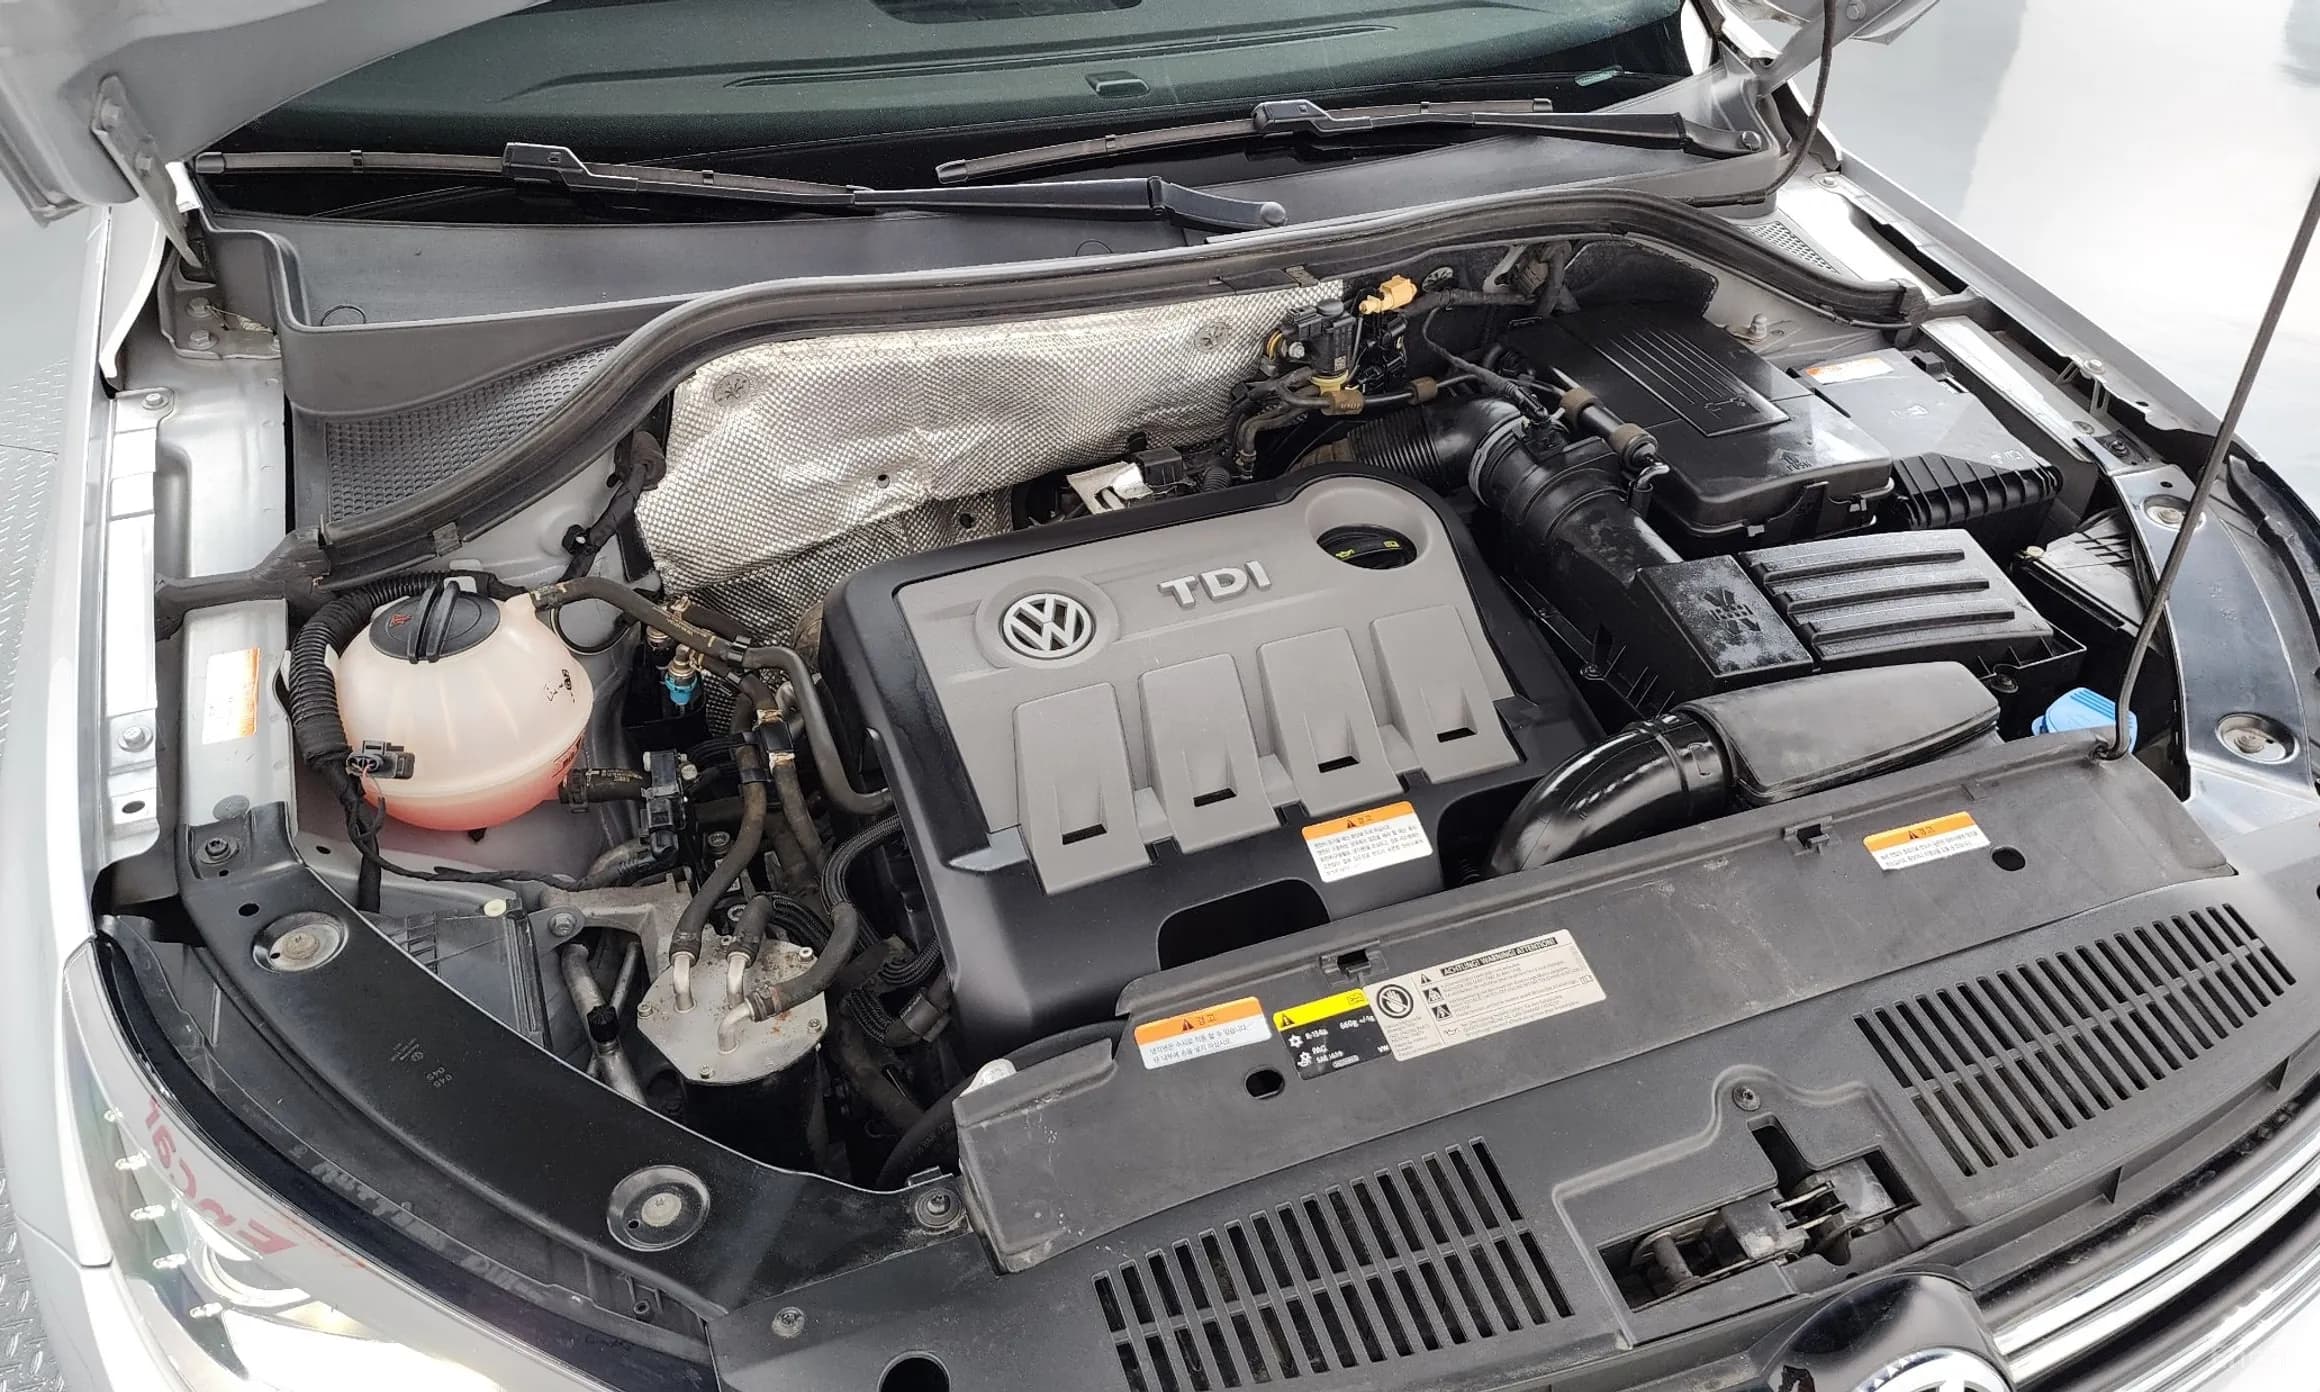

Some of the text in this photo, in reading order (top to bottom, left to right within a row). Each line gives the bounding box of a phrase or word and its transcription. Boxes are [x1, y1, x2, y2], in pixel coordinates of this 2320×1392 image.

[1158, 559, 1271, 608] TDI
[1002, 592, 1093, 659] VW
[1196, 1013, 1216, 1026] 경고
